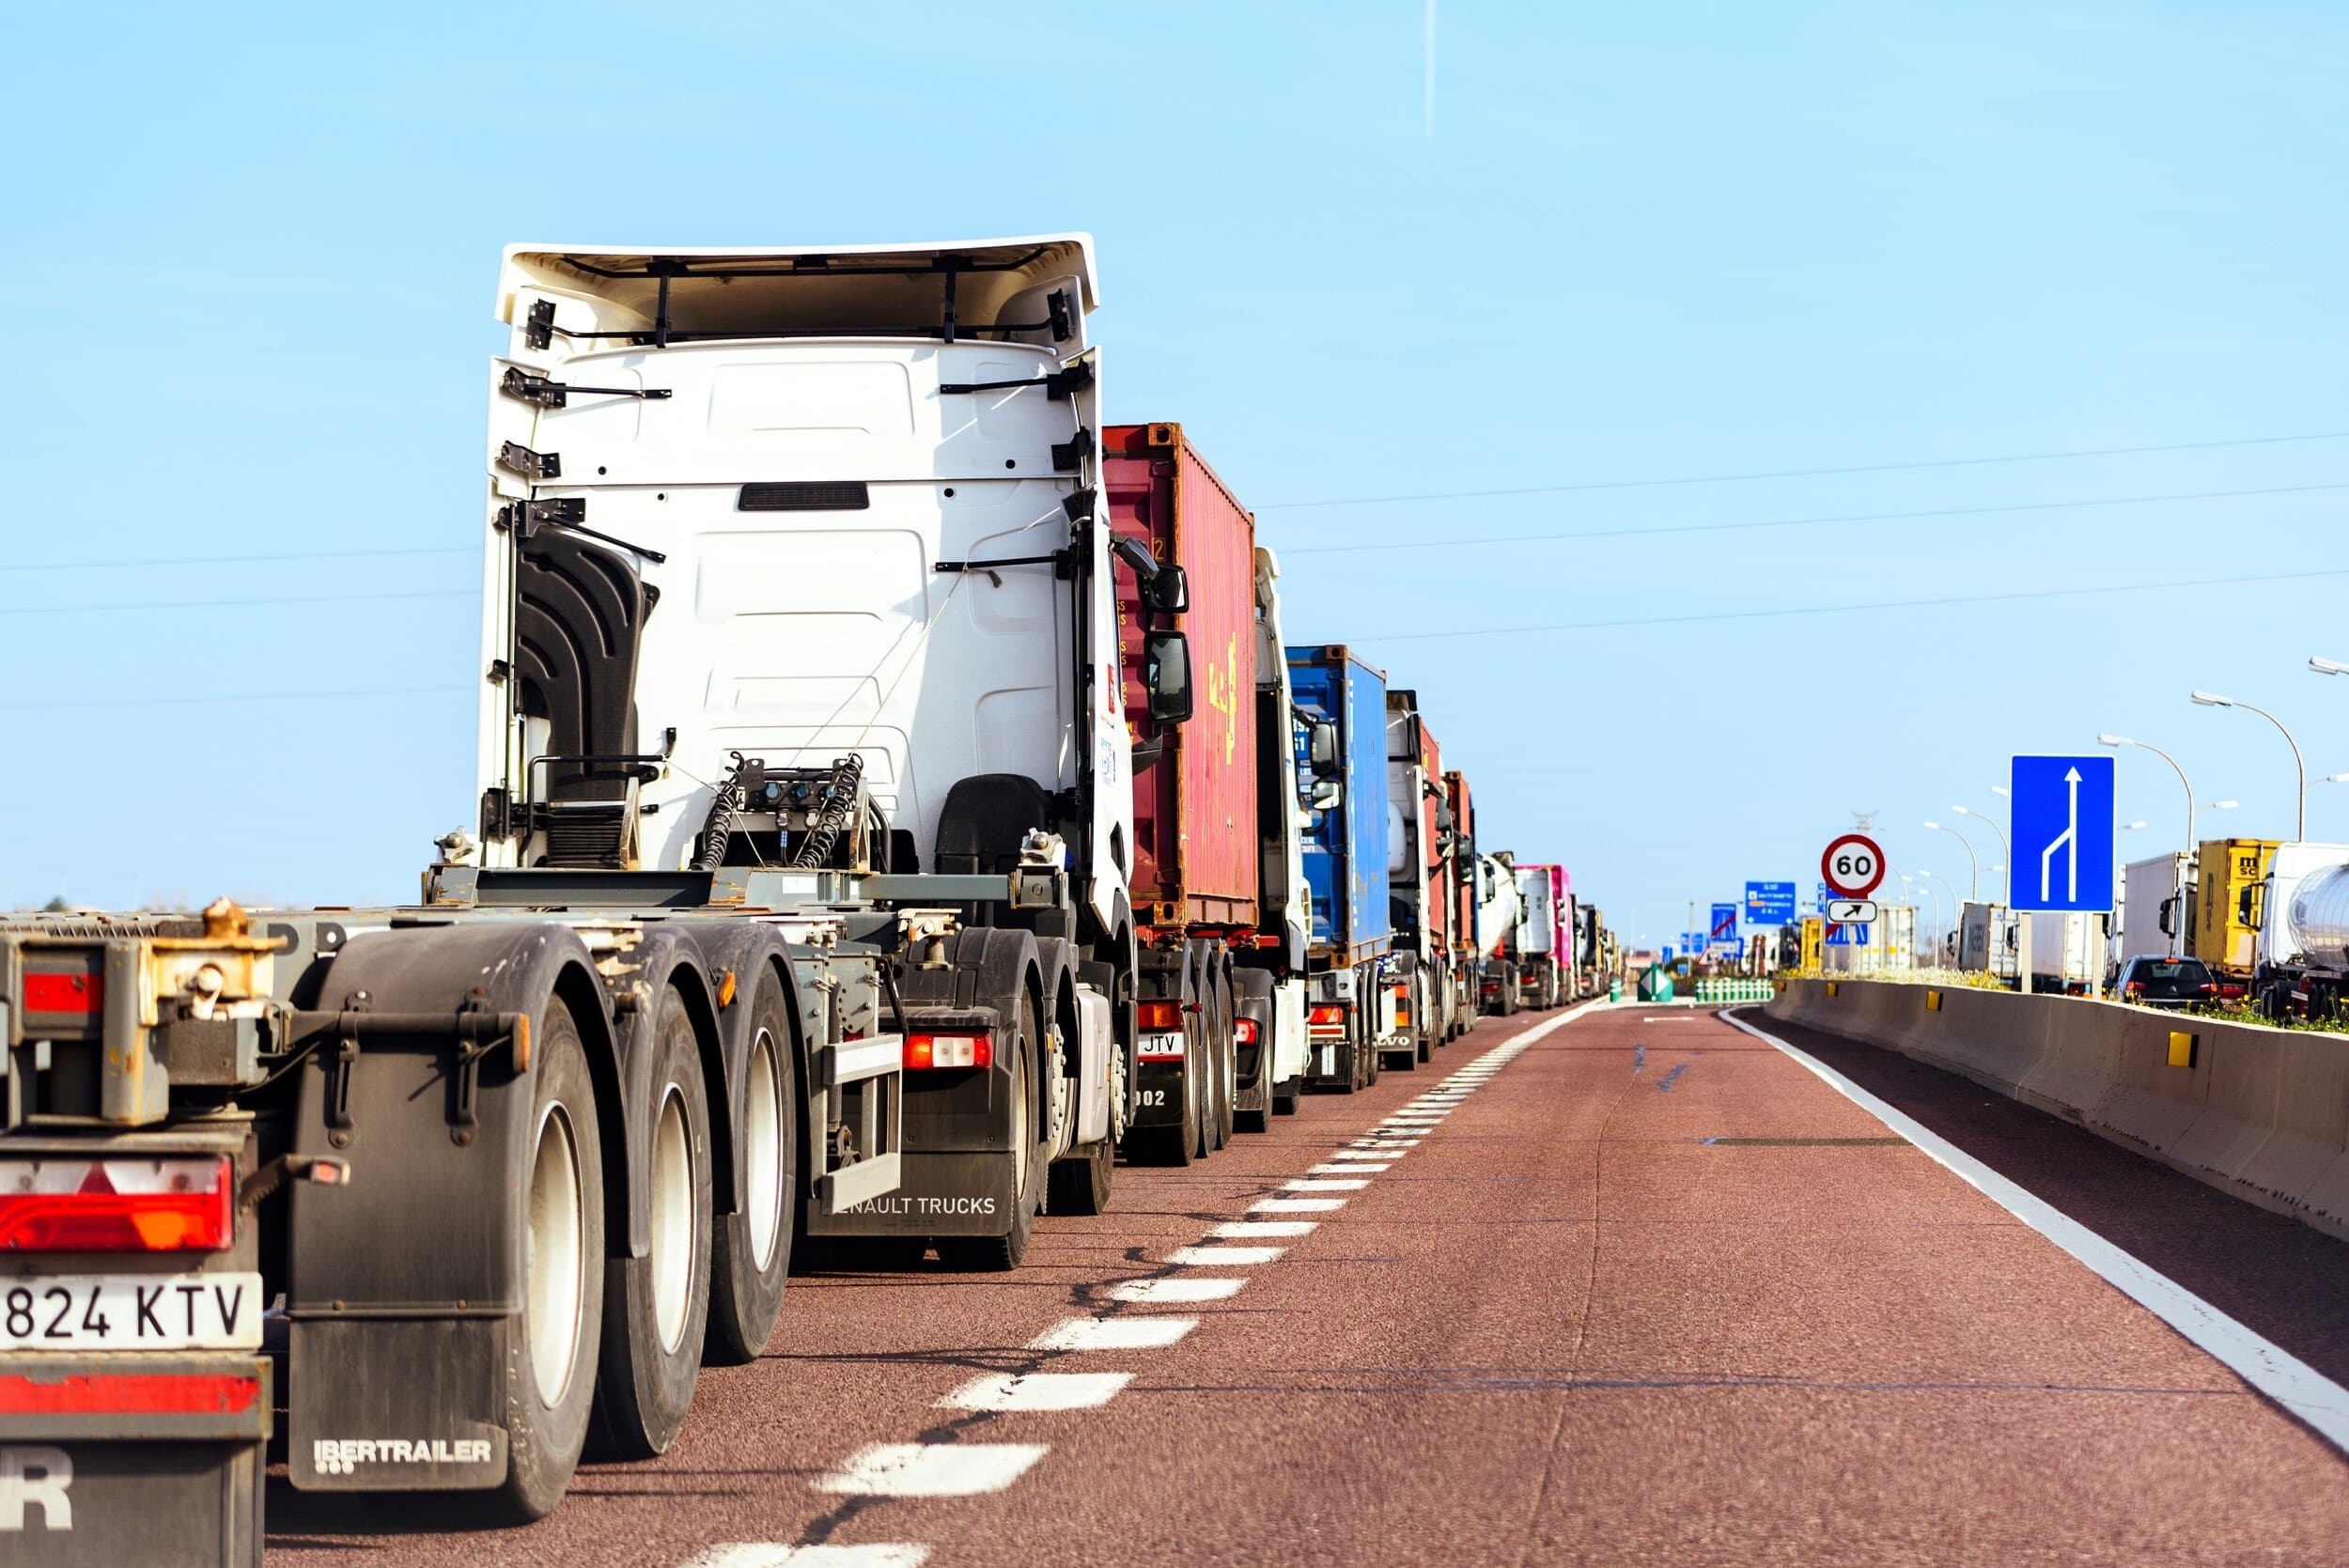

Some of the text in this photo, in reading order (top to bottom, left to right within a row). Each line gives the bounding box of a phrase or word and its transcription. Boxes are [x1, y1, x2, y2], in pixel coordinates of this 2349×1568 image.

[1836, 855, 1872, 876] 60
[1143, 1035, 1174, 1052] JTV
[837, 1197, 996, 1215] NAULT TRUCKS
[6, 1285, 243, 1338] 824 KTV
[313, 1439, 491, 1463] IBERTRAILER
